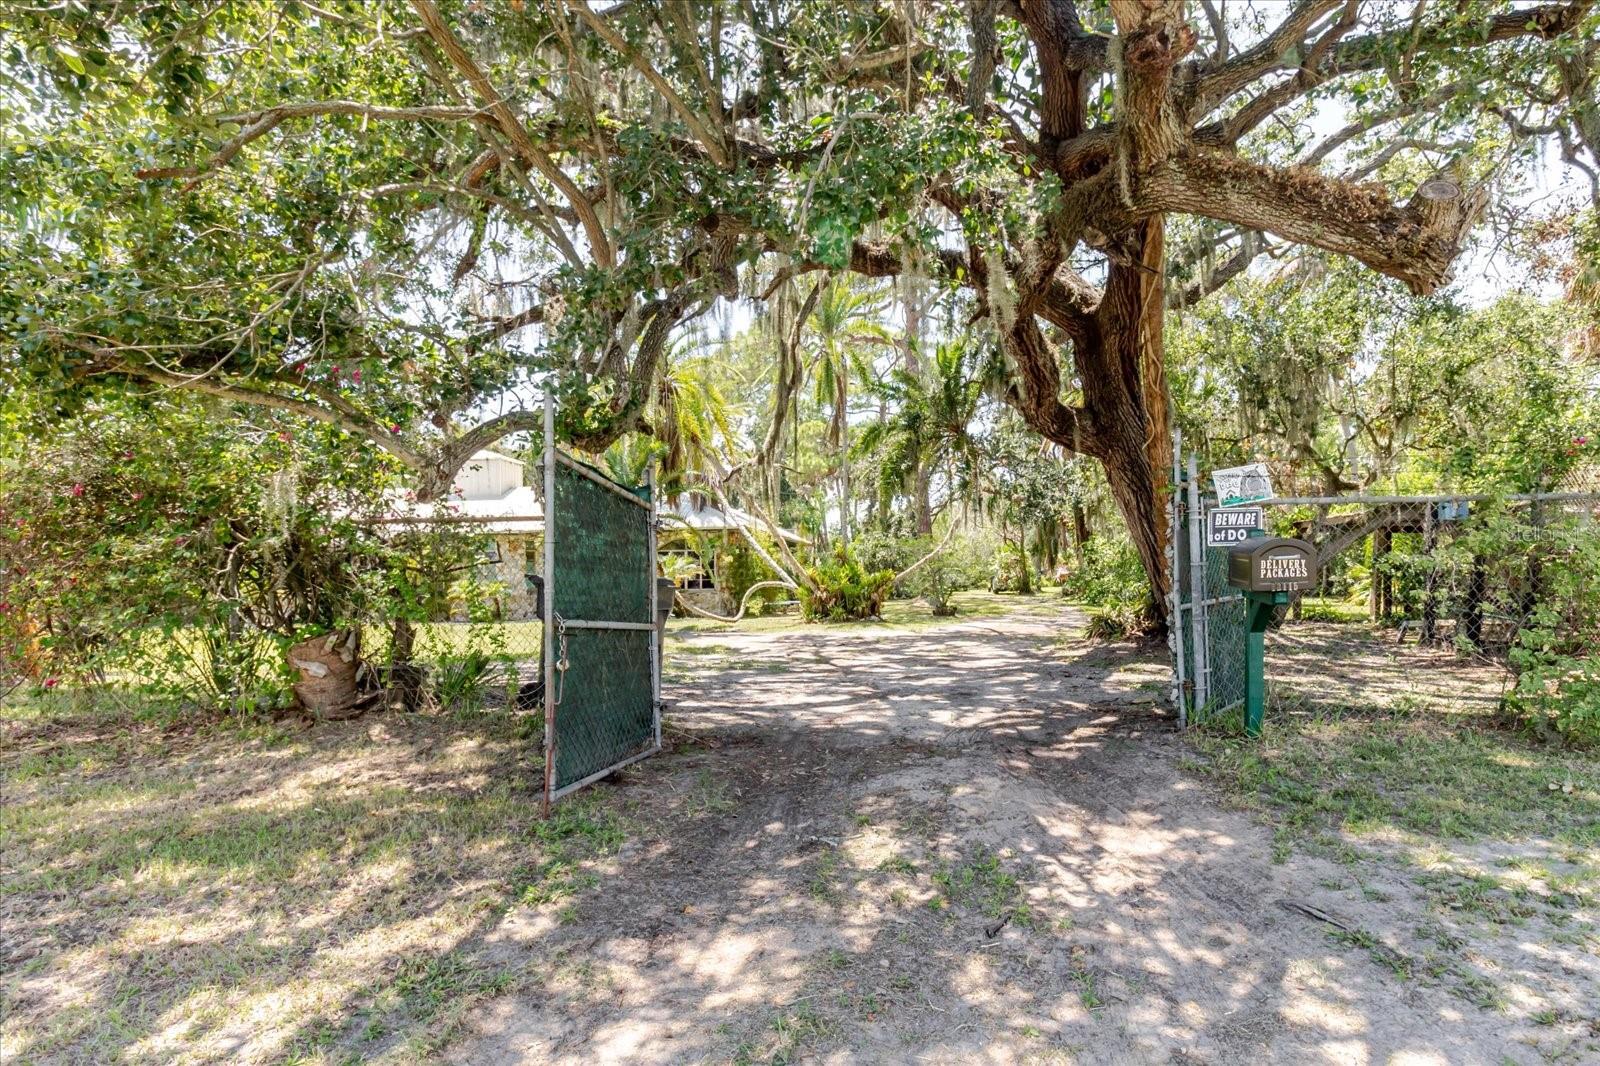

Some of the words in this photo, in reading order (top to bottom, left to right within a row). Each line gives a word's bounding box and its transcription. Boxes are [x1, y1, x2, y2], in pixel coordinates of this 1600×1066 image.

[1215, 513, 1257, 526] BEWARE
[1214, 530, 1226, 541] of
[1227, 529, 1247, 541] DO
[1260, 559, 1306, 569] DELIVERY
[1260, 568, 1308, 579] PACKAGES
